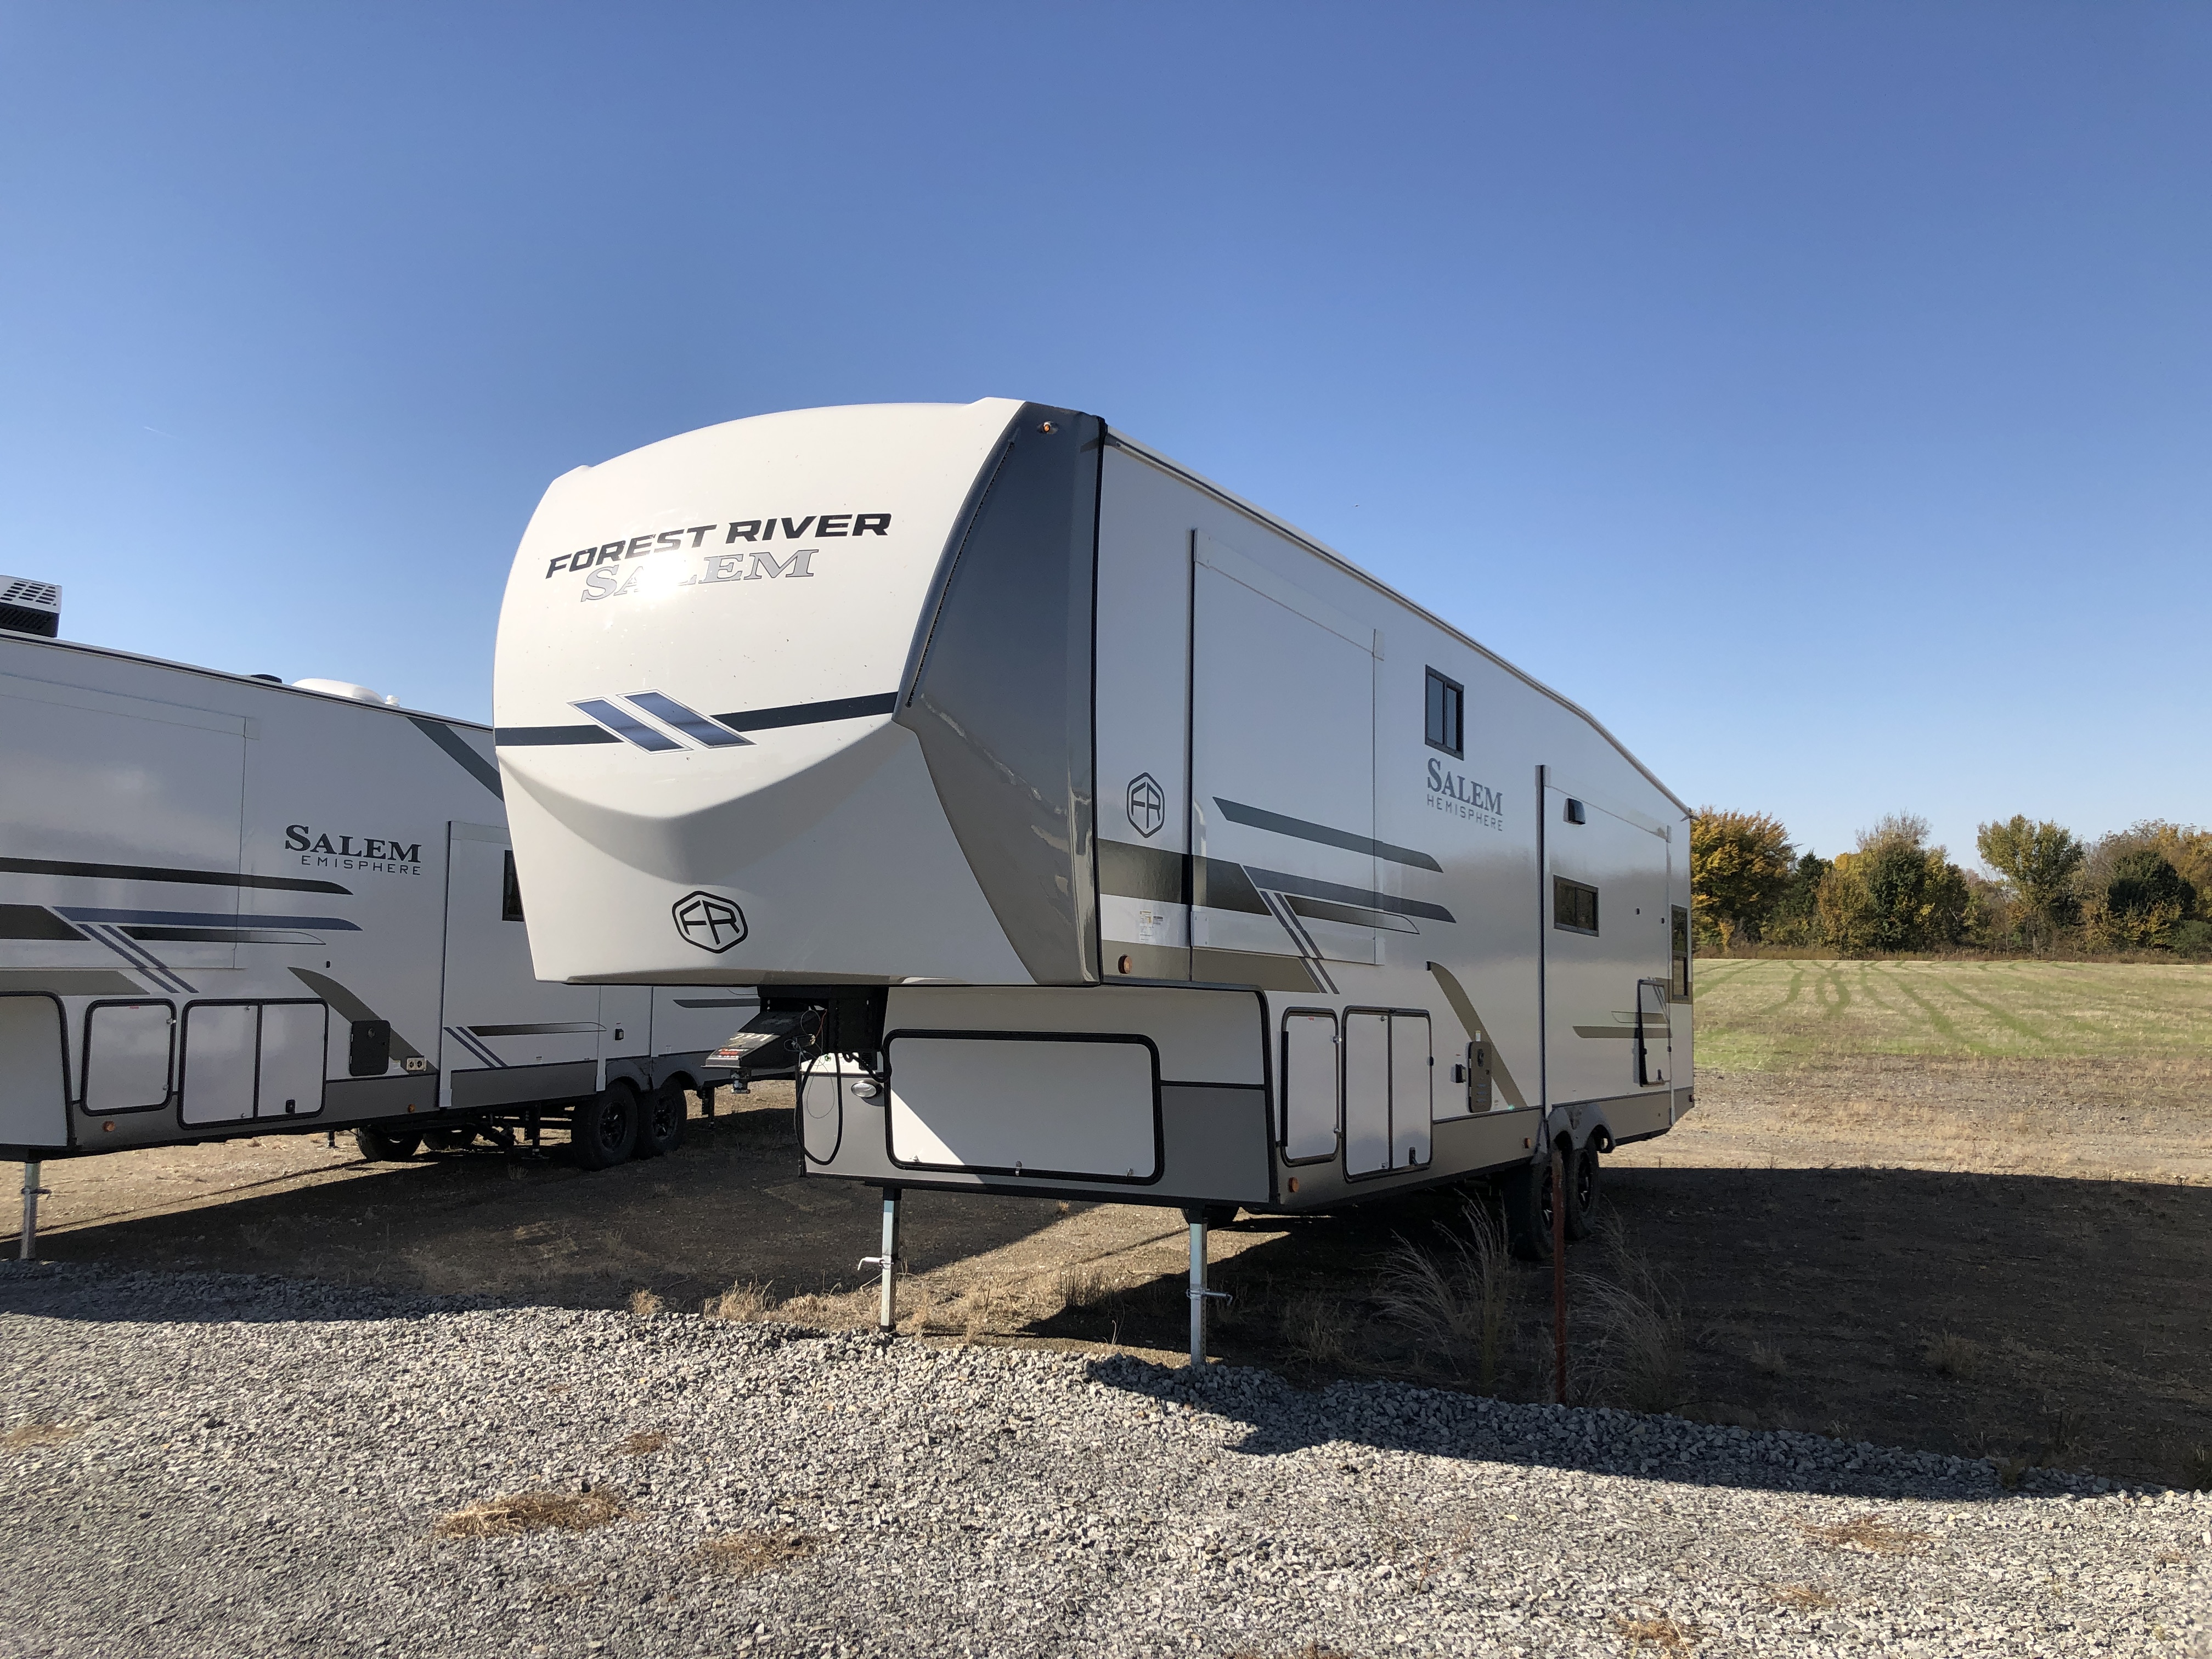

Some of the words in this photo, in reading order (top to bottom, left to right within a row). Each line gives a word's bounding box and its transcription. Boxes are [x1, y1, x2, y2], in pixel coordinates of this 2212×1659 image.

[545, 523, 718, 579] FOREST
[725, 513, 893, 544] RIVER
[1427, 757, 1503, 816] SALEM
[1426, 793, 1503, 832] HEMISPHERE
[284, 824, 422, 864] SALEM
[301, 855, 421, 876] EMISPHERE
